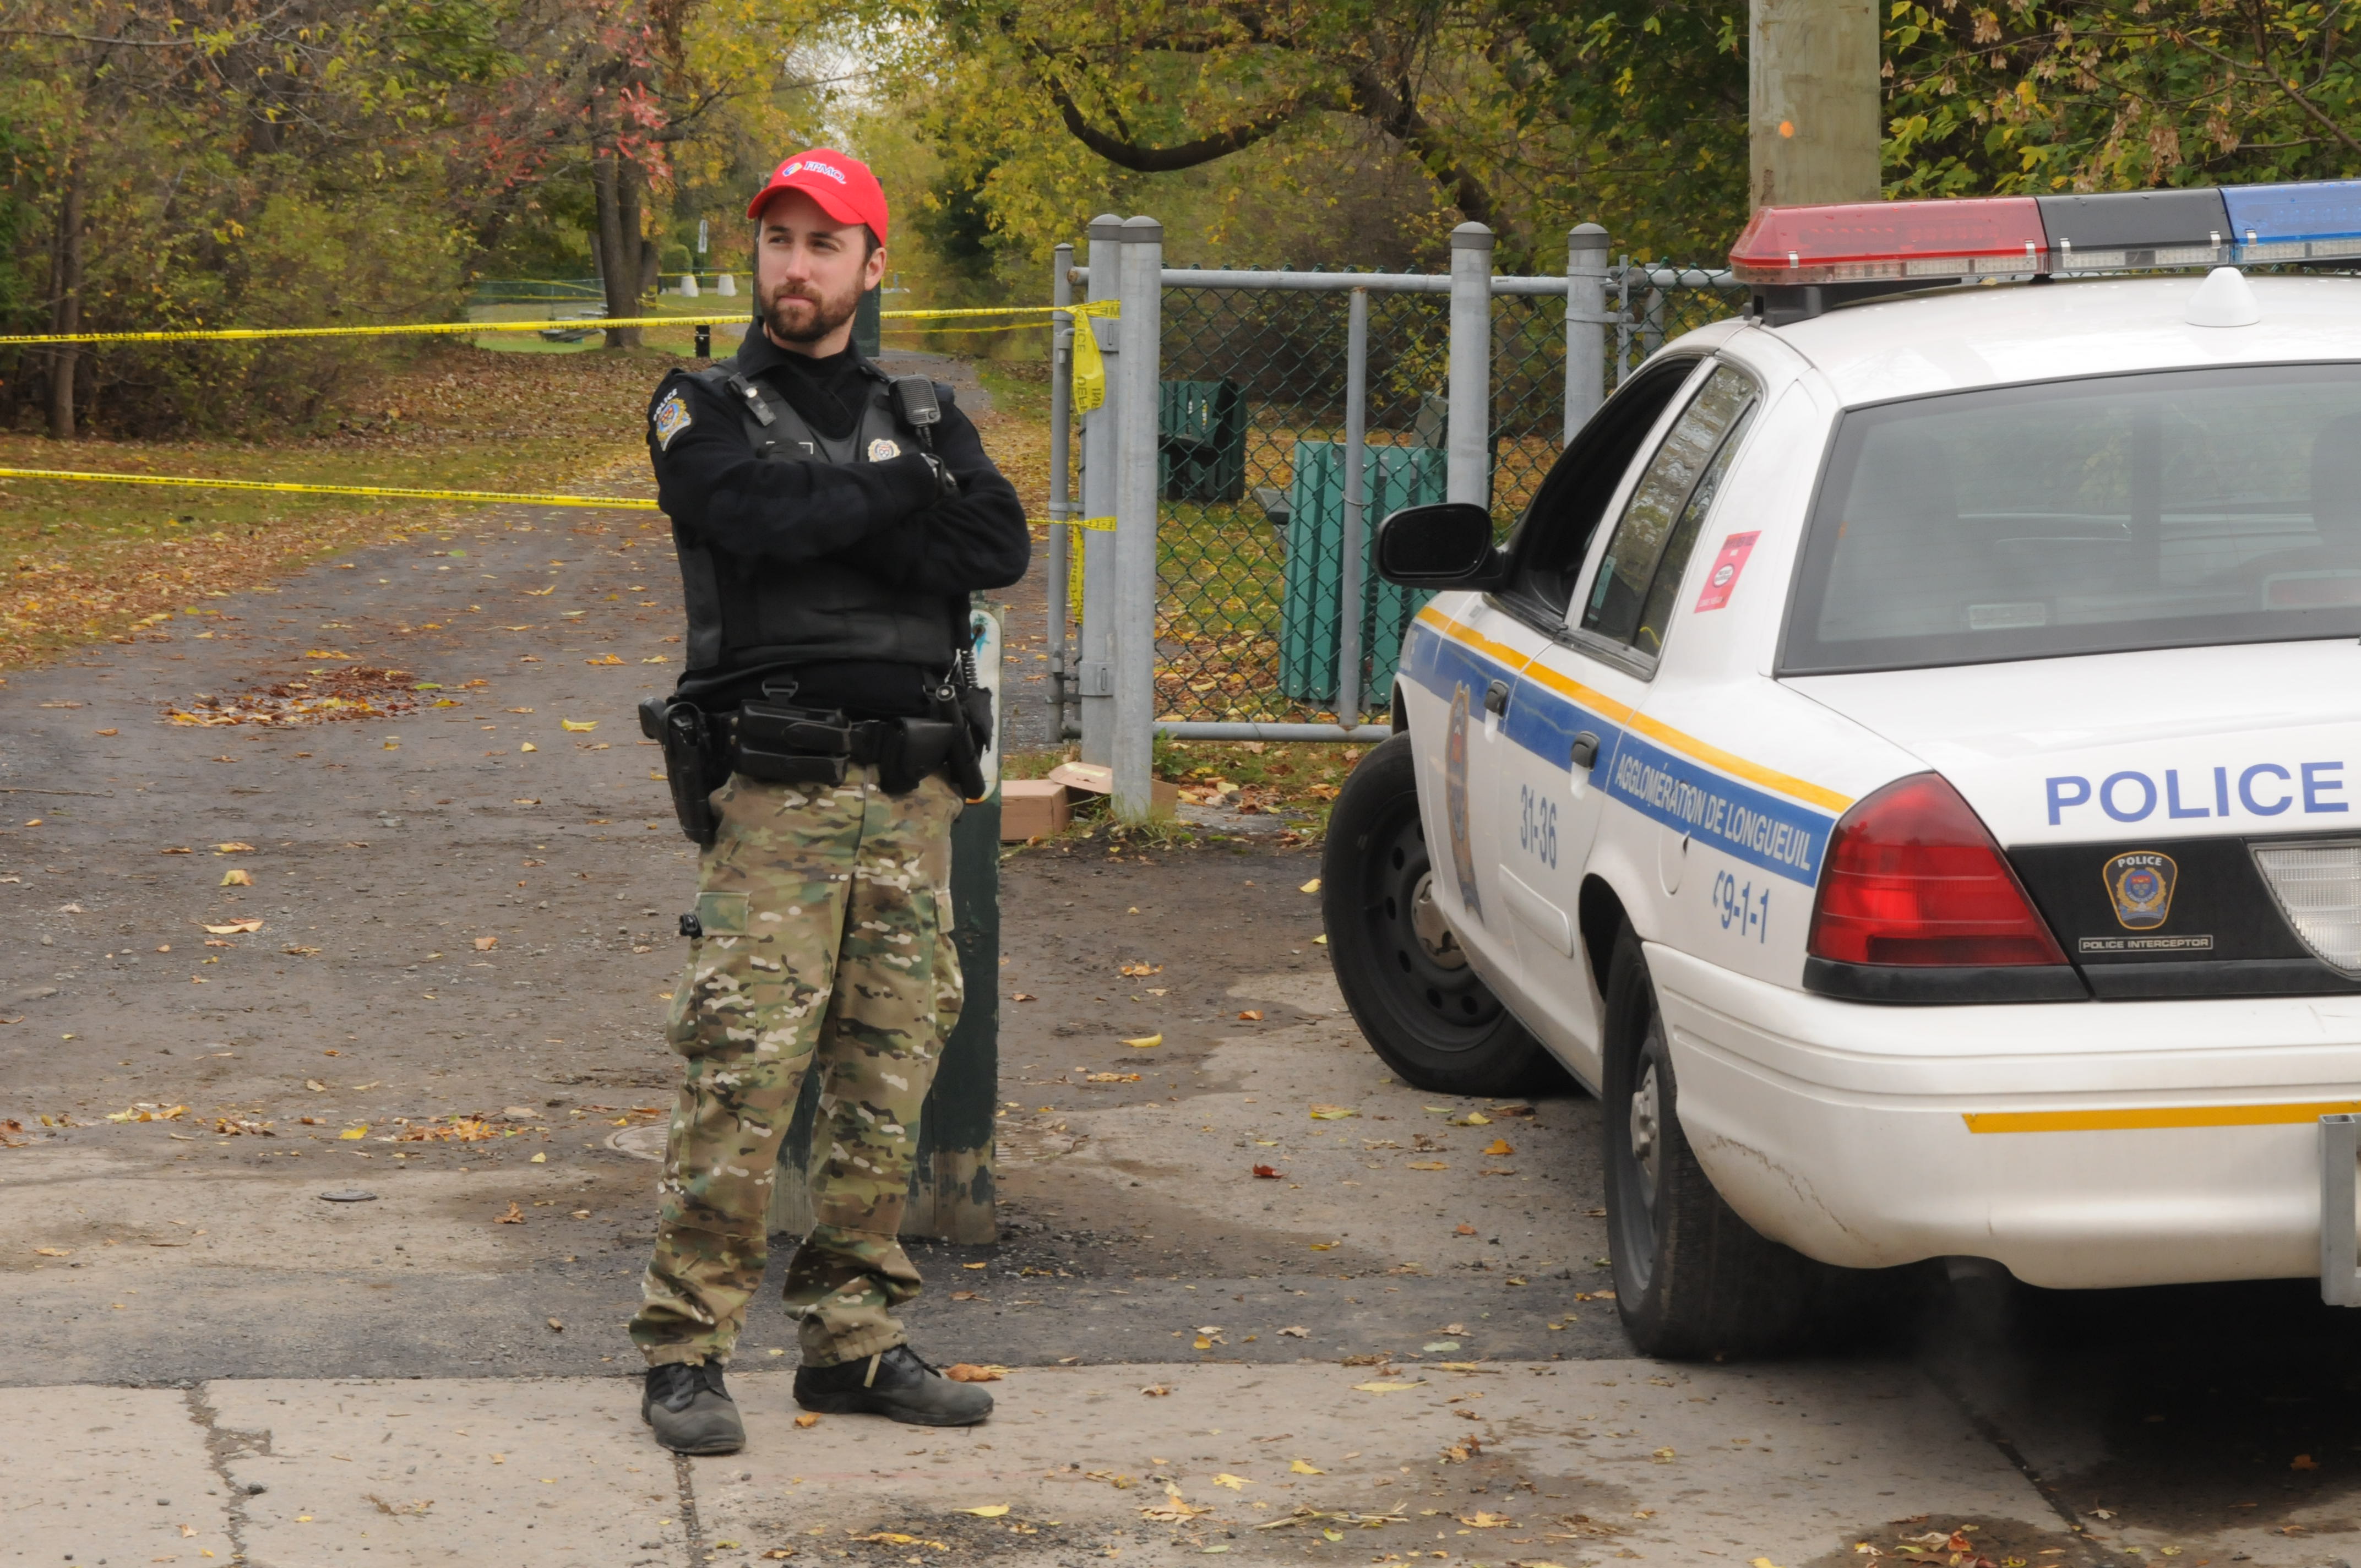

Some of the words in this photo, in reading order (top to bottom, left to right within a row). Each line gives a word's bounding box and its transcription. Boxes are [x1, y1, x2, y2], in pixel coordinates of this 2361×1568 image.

[803, 161, 847, 184] FPMQ
[653, 388, 678, 422] POLICE
[1614, 753, 1704, 826] AGGLOMÉRATION
[1703, 793, 1728, 834] DE
[1724, 802, 1811, 872] LONGUEUIL
[2046, 761, 2349, 826] POLICE
[1520, 783, 1557, 870] 31-36
[2117, 856, 2163, 868] POLICE
[1722, 872, 1770, 944] 9-1-1
[2082, 940, 2124, 949] POLICE
[2127, 938, 2209, 948] INTERCEPTOR
